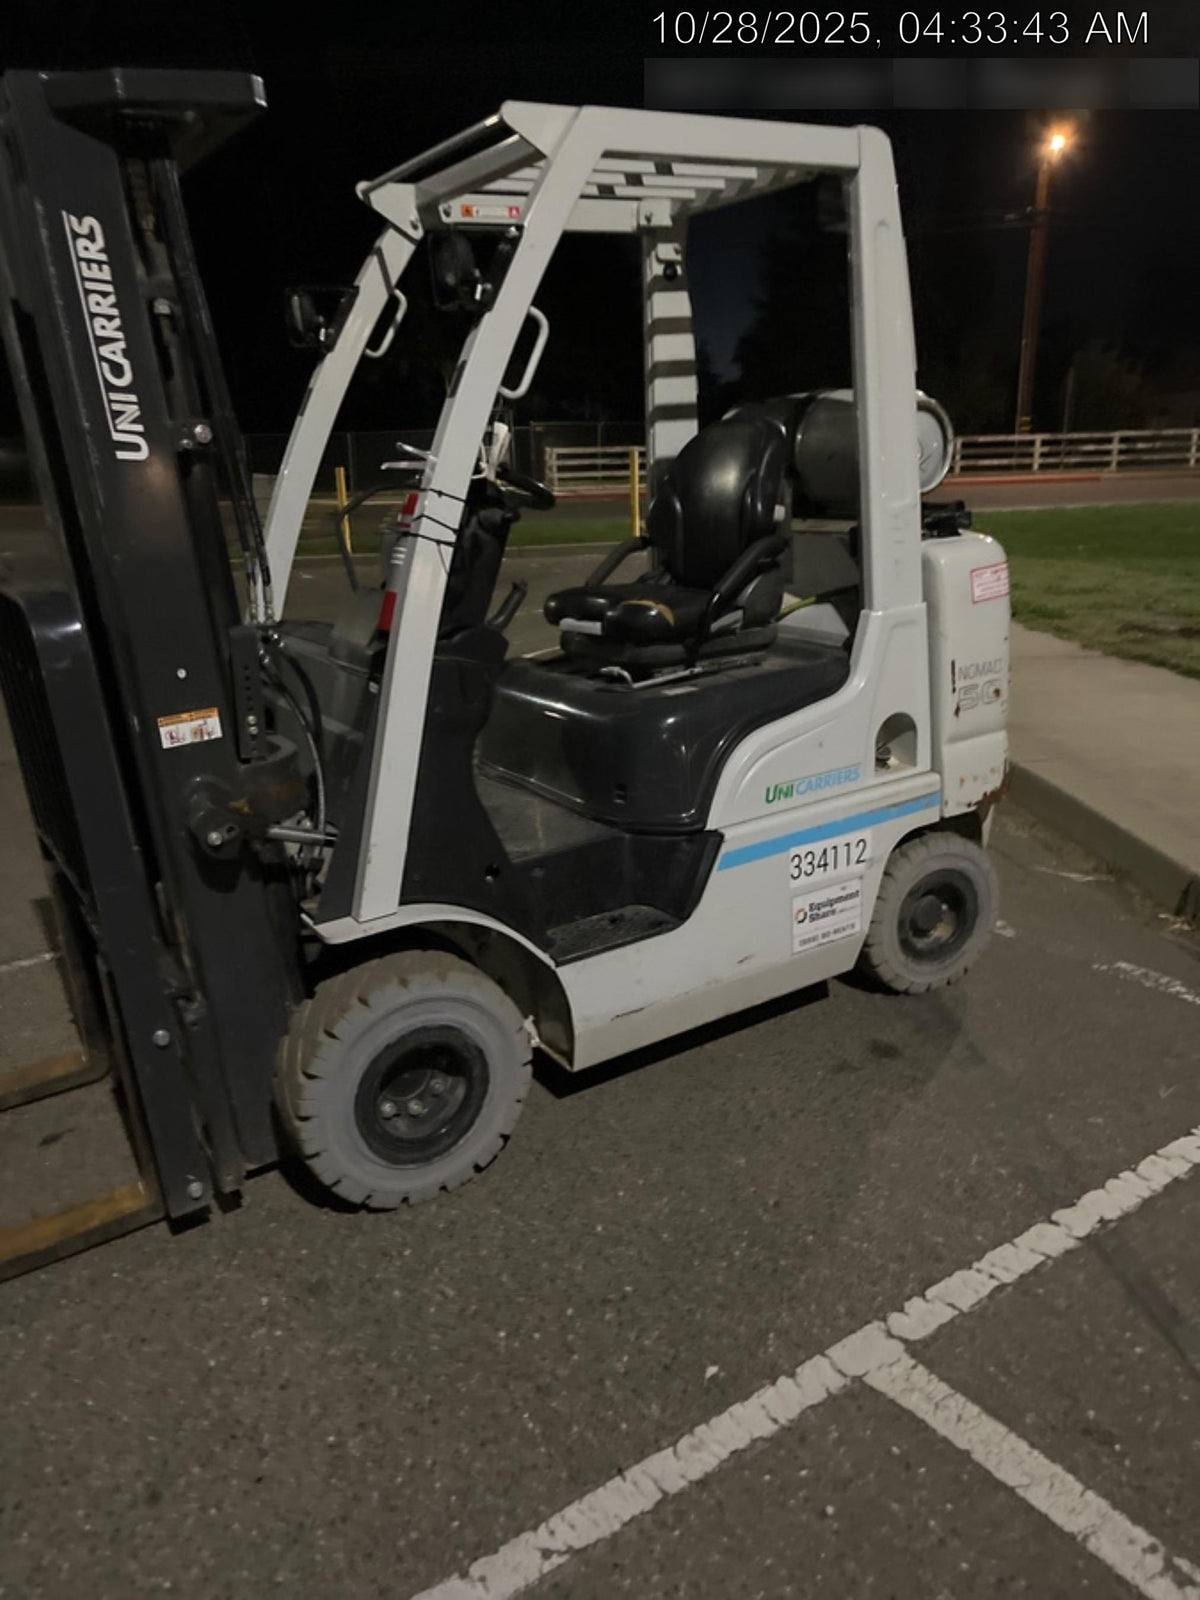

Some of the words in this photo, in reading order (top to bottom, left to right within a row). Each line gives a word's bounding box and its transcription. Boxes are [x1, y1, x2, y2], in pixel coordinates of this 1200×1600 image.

[790, 838, 867, 880] 334112
[808, 889, 860, 912] Equipment
[808, 908, 837, 923] Share
